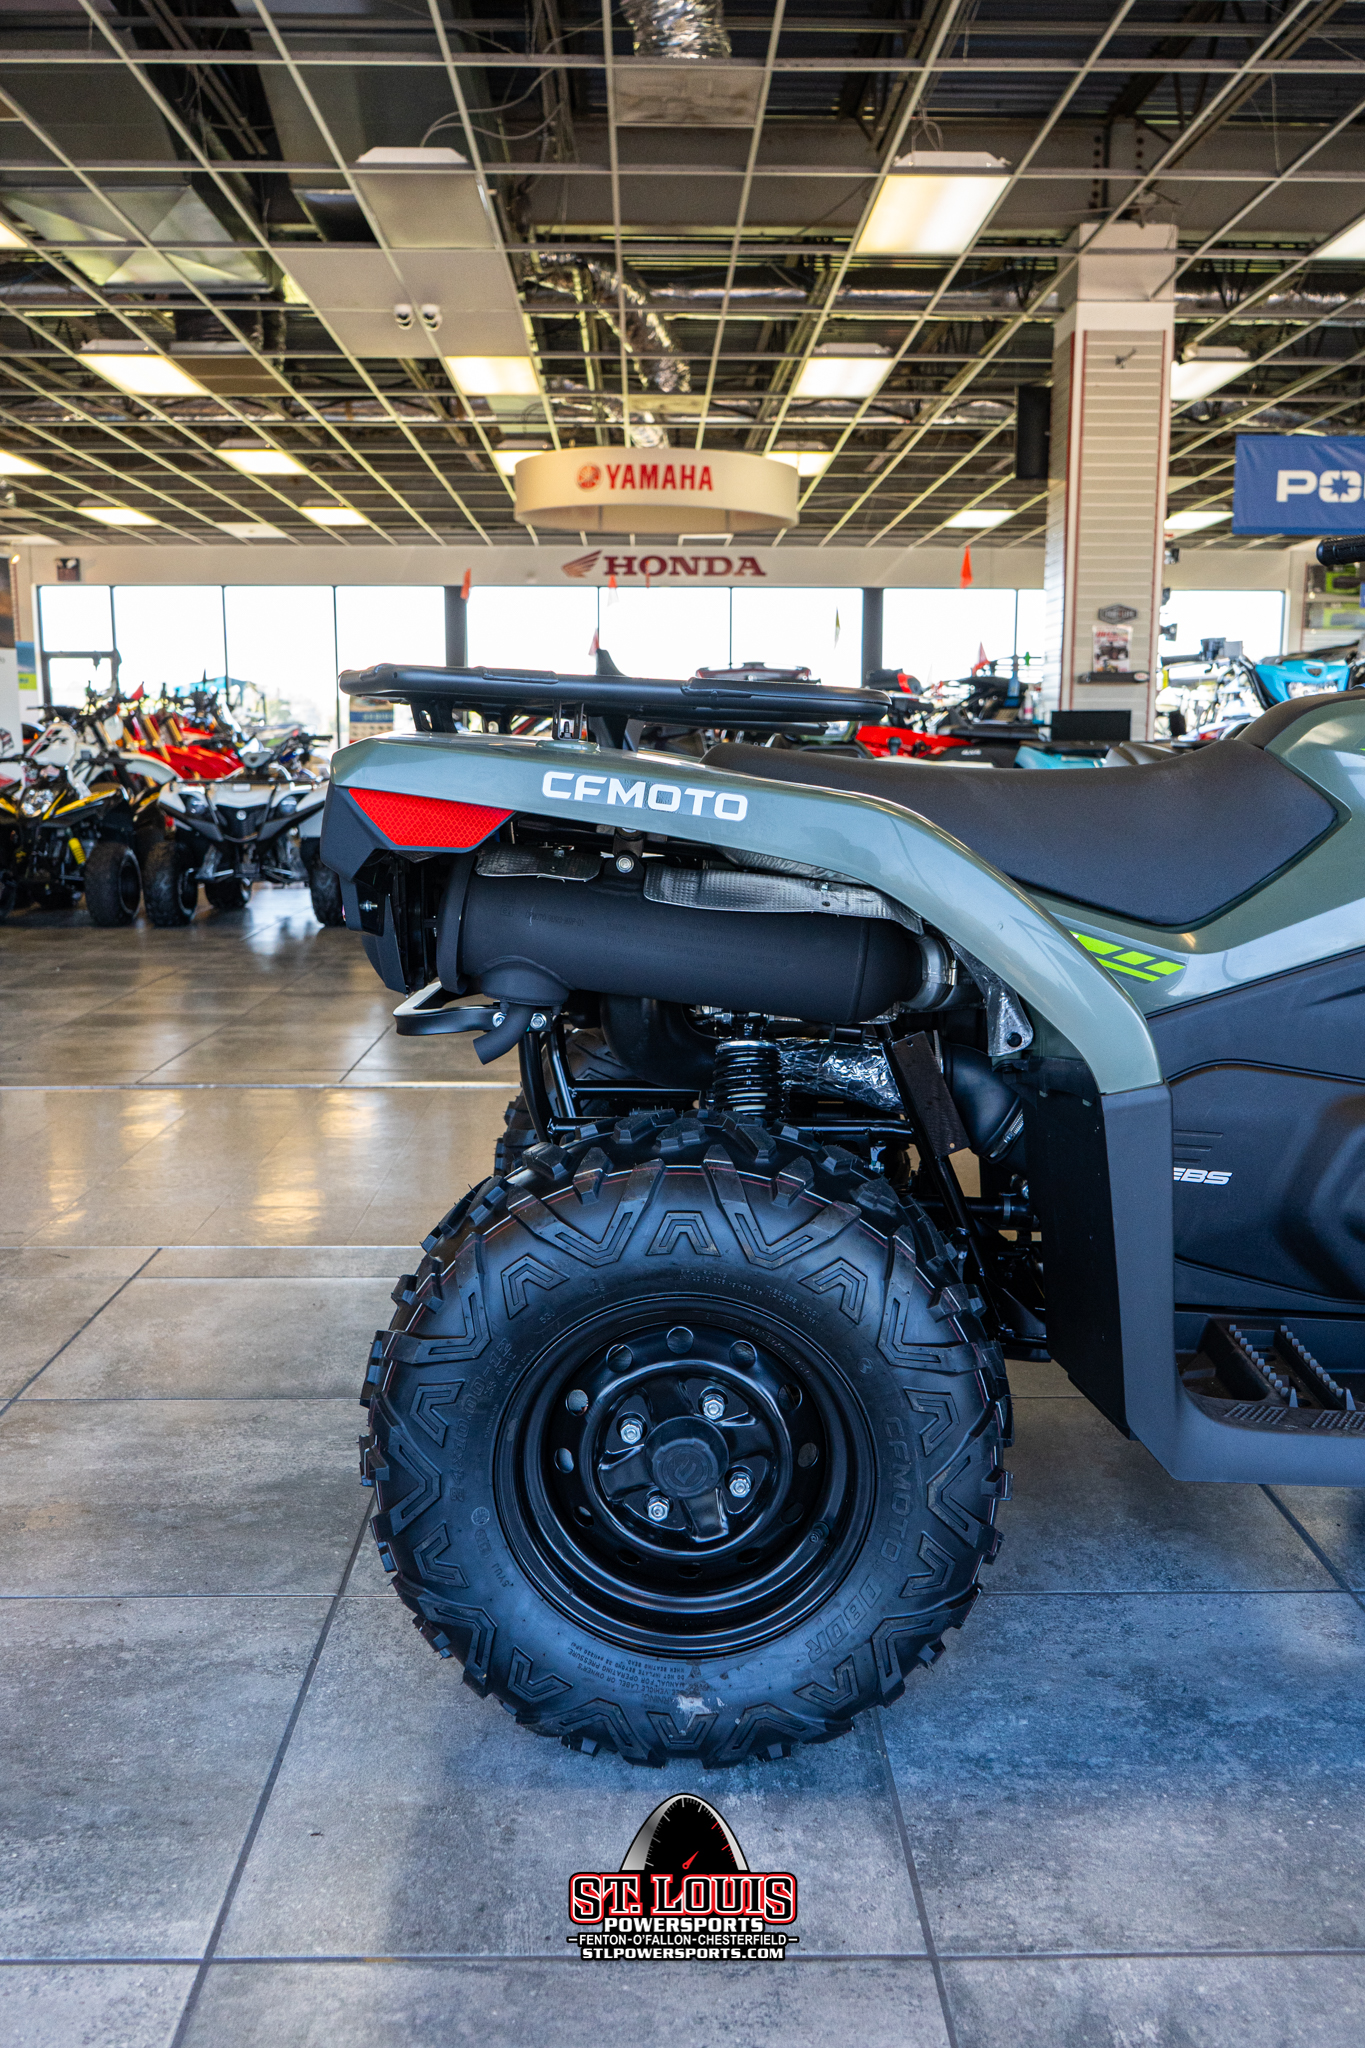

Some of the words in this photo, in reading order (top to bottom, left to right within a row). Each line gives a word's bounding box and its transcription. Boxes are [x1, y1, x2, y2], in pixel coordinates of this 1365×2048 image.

[605, 463, 713, 491] YAMAHA
[1276, 469, 1365, 503] PO
[603, 555, 766, 577] HONDA
[542, 771, 749, 822] CFMOTO
[881, 1416, 913, 1564] CFMOTO
[576, 1662, 604, 1678] OWNER'S
[601, 1665, 638, 1682] OPERATING
[618, 1678, 638, 1689] LABEL
[640, 1677, 654, 1685] FOR
[640, 1684, 668, 1694] VEHICLE
[657, 1679, 684, 1687] MANUAL
[641, 1693, 679, 1704] ARNING:
